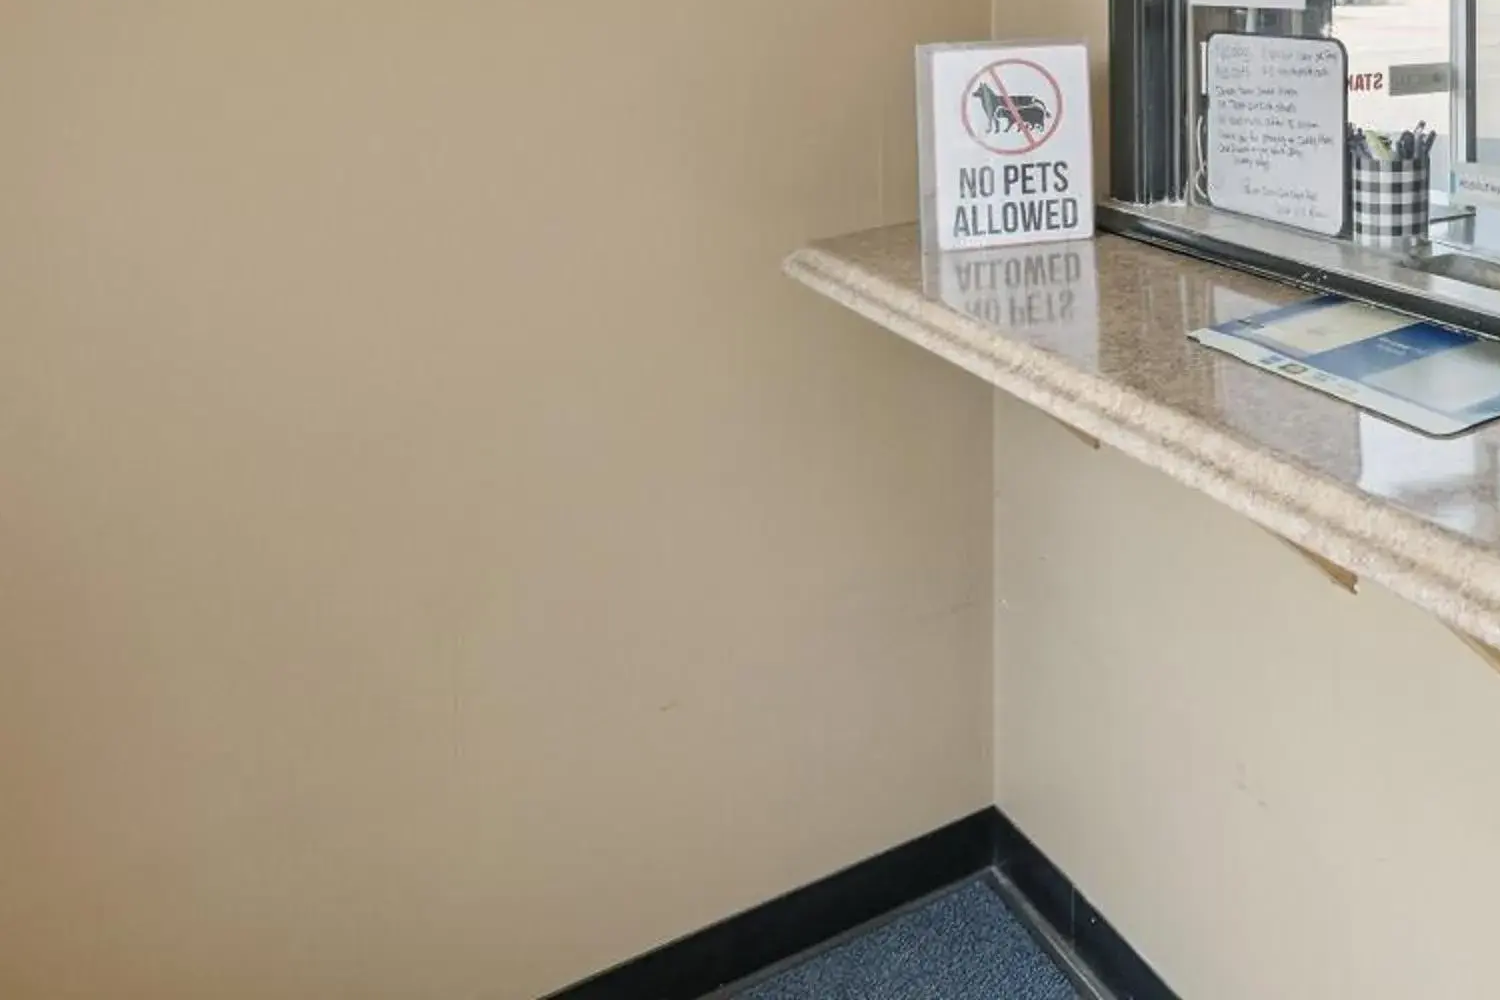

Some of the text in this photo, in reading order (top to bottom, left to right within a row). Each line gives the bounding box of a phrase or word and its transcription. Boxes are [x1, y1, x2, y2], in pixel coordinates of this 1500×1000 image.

[958, 159, 1069, 199] NO PETS
[953, 197, 1080, 239] ALLOWED
